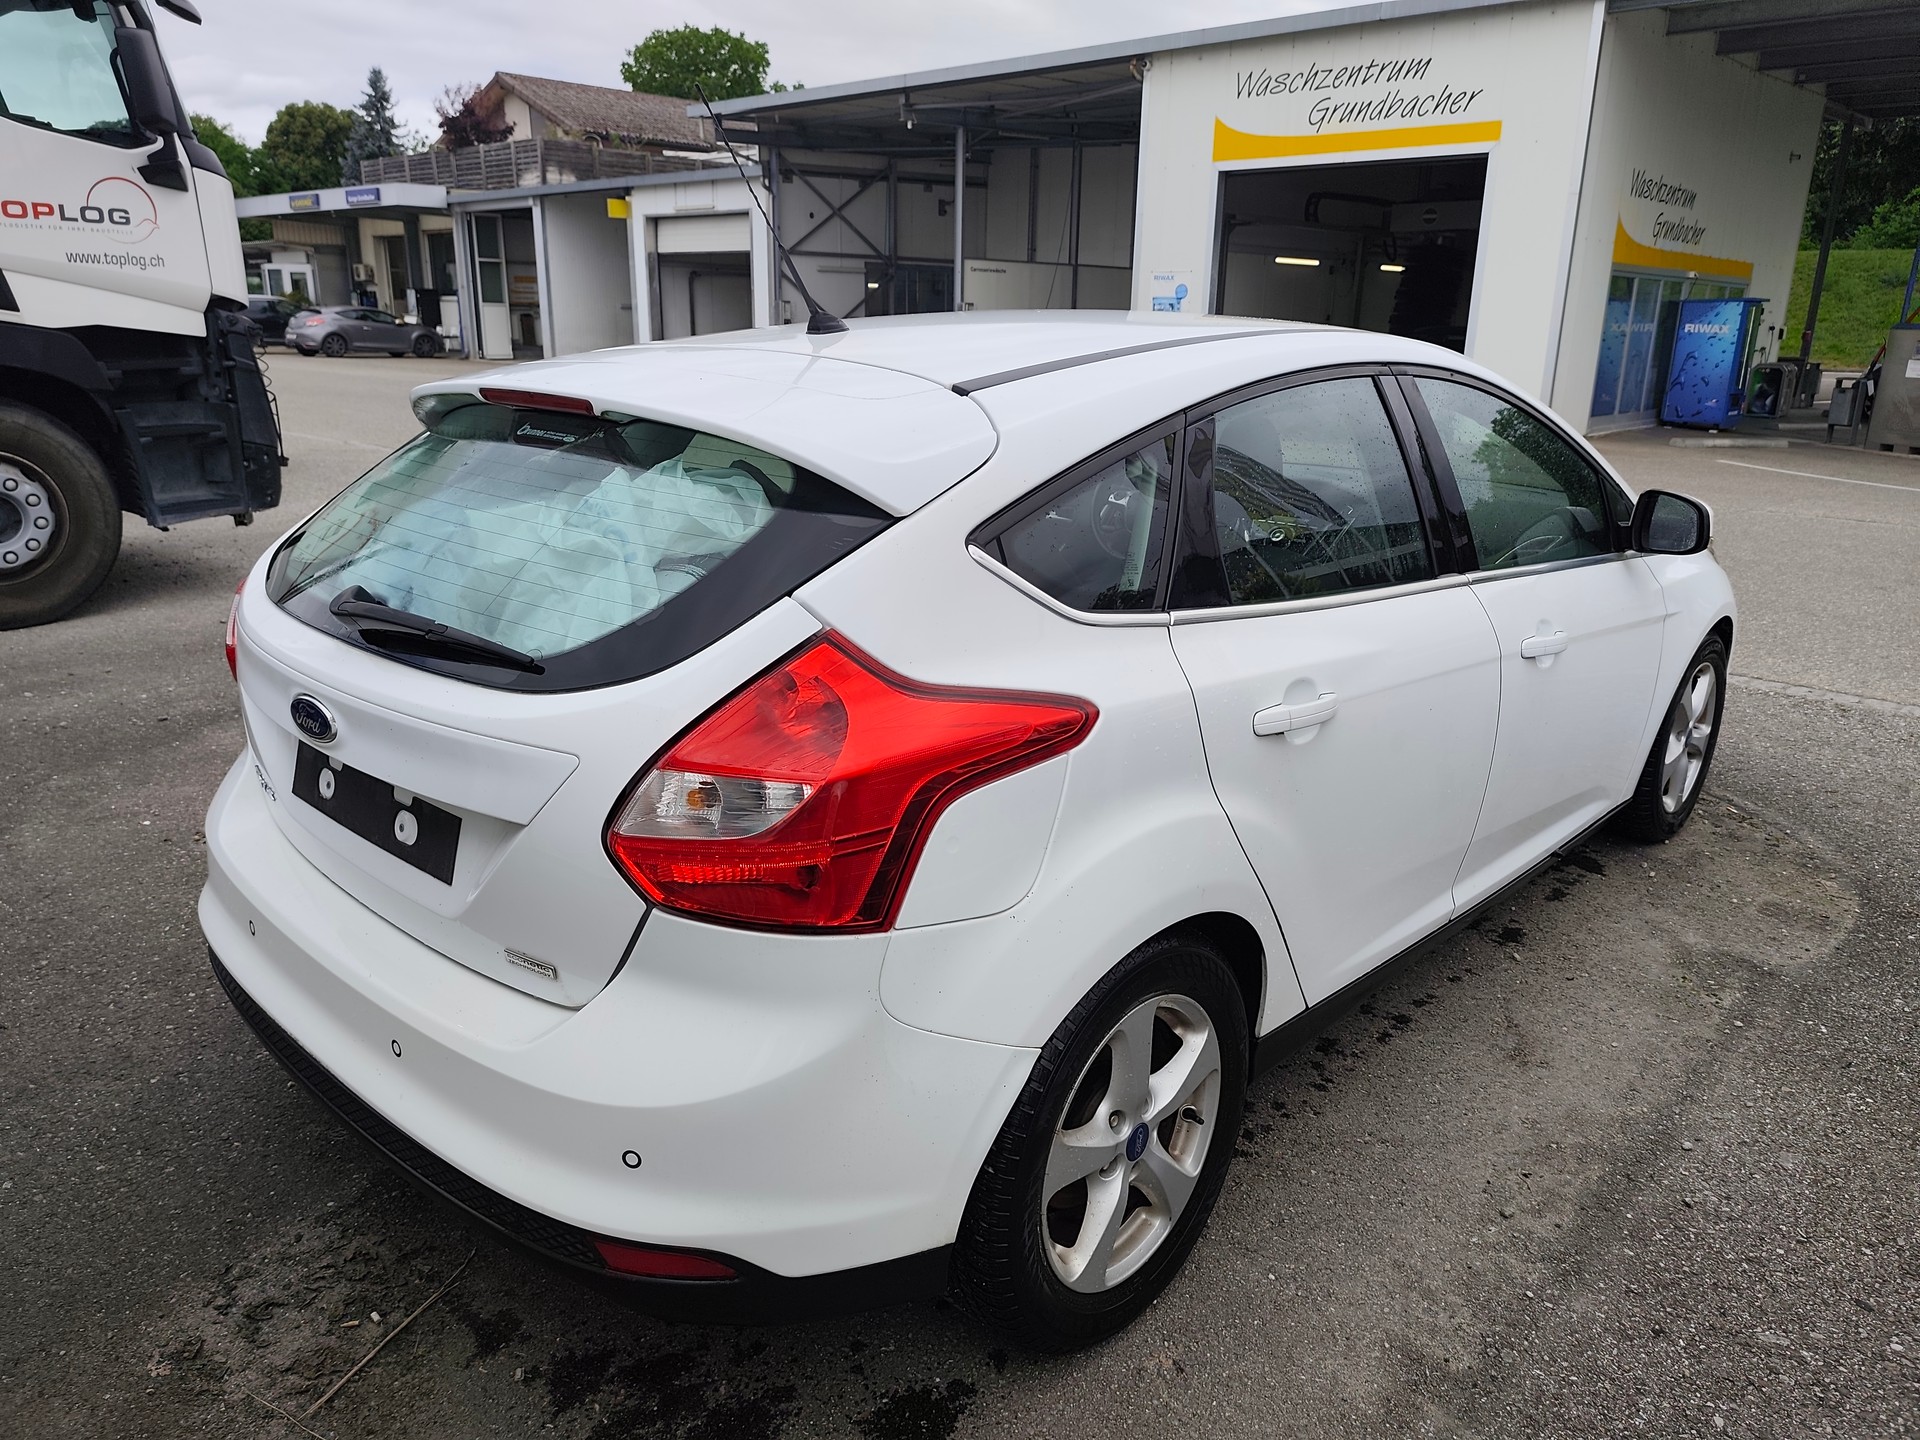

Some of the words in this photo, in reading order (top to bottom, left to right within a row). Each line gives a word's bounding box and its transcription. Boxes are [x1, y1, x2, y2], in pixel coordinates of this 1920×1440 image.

[1236, 57, 1432, 99] Waschzentrum
[1308, 84, 1484, 133] Grundbacher
[1630, 167, 1697, 211] Waschzentrum
[0, 200, 131, 226] OPLOG
[1653, 212, 1706, 246] Grundbacher
[65, 252, 165, 271] www.toplog.ch
[1684, 323, 1729, 333] RIWAX
[295, 703, 321, 733] Ford
